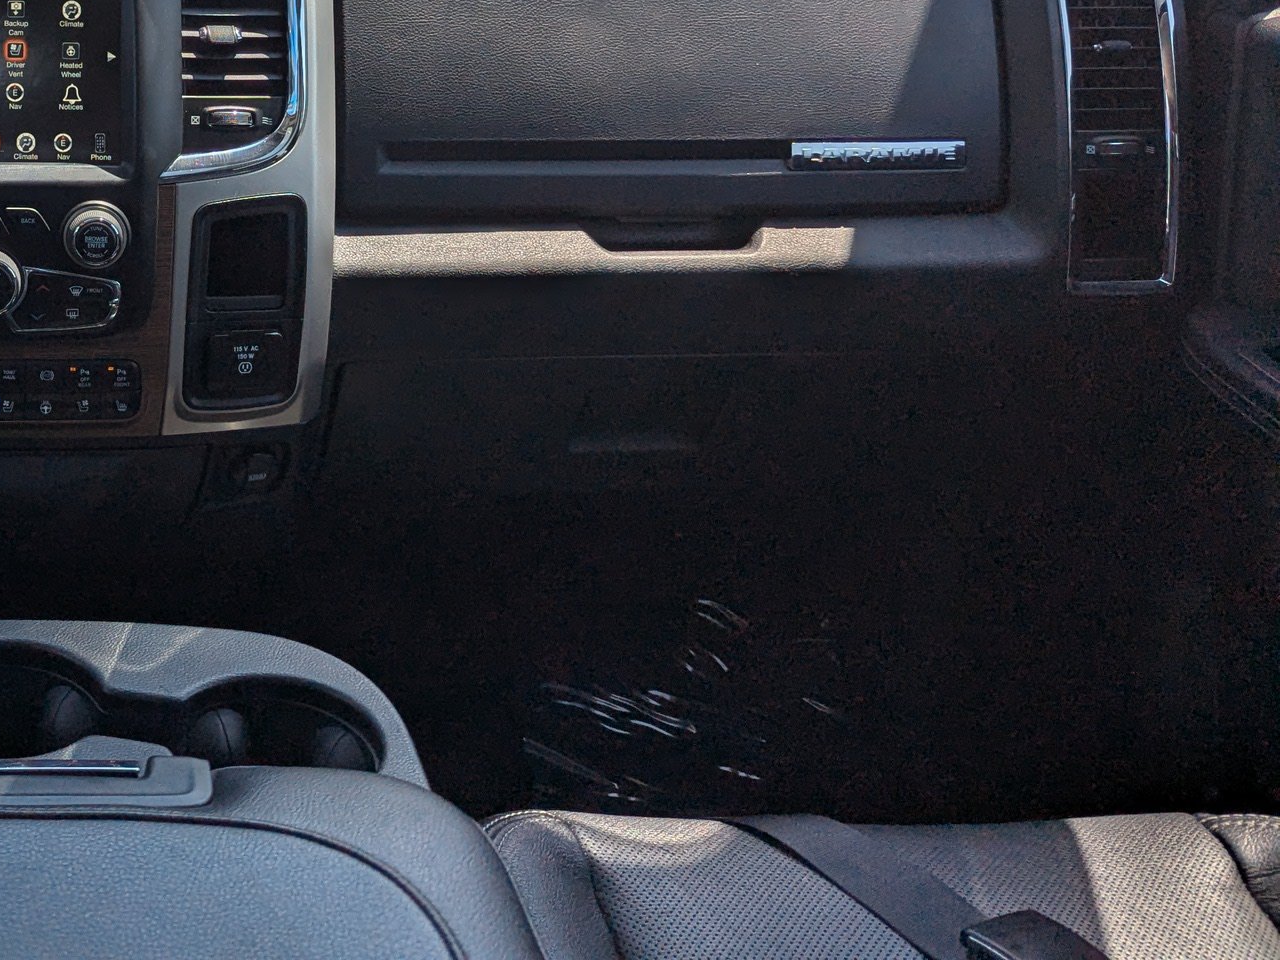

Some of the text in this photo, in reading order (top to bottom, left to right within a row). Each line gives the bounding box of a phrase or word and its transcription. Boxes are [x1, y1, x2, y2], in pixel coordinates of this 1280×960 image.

[3, 20, 29, 29] Backup
[59, 20, 84, 28] Climate
[8, 29, 24, 37] Cam
[6, 61, 26, 69] Driver
[59, 61, 84, 69] Heated
[8, 70, 24, 78] Vent
[58, 103, 84, 111] Notices
[90, 153, 112, 161] Phone
